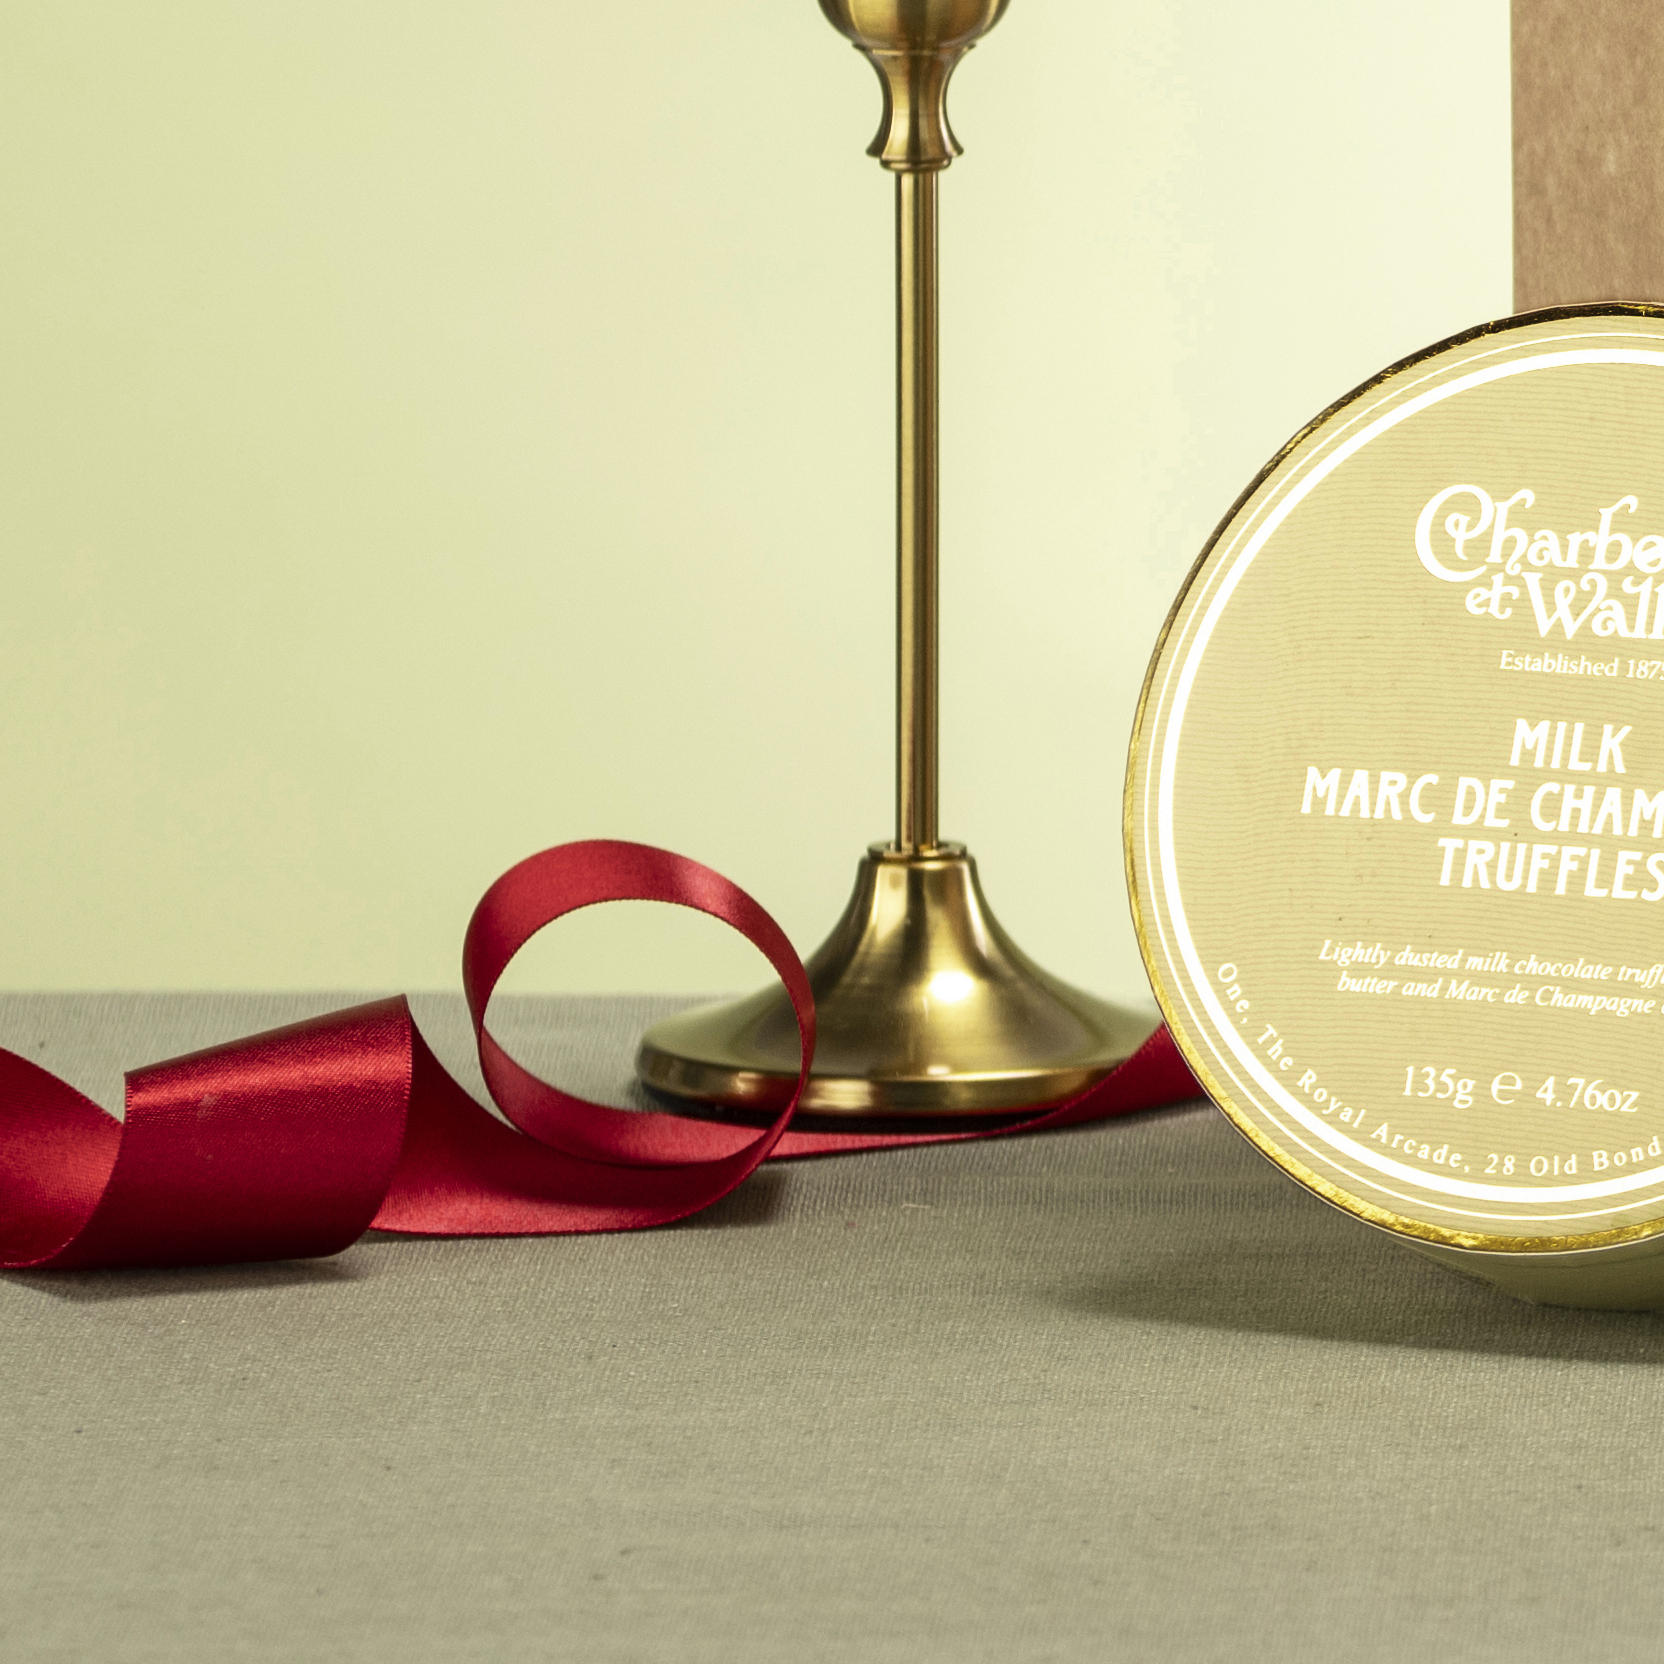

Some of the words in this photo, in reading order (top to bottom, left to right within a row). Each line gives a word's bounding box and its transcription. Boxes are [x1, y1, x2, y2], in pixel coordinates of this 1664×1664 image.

[1465, 572, 1520, 619] et
[1500, 650, 1618, 676] Established
[1510, 719, 1632, 773] MILK
[1301, 767, 1438, 823] MARC
[1452, 777, 1515, 827] DE
[1319, 940, 1390, 968] Lightly
[1395, 945, 1463, 968] dusted
[1465, 952, 1509, 972] milk
[1514, 954, 1612, 979] chocolate
[1337, 971, 1398, 994] butter
[1402, 978, 1442, 997] and
[1445, 980, 1499, 1002] Marc
[1504, 984, 1528, 1004] de
[1536, 986, 1656, 1016] Champagne
[1218, 962, 1249, 1024] One,
[1257, 1024, 1293, 1070] The
[1297, 1069, 1366, 1128] Royal
[1370, 1123, 1469, 1172] Arcade,
[1484, 1154, 1515, 1175] 28
[1530, 1154, 1576, 1176] Old
[1593, 1136, 1661, 1170] Bond
[1403, 1066, 1475, 1108] 135g
[1536, 1076, 1639, 1112] 4.76oz
